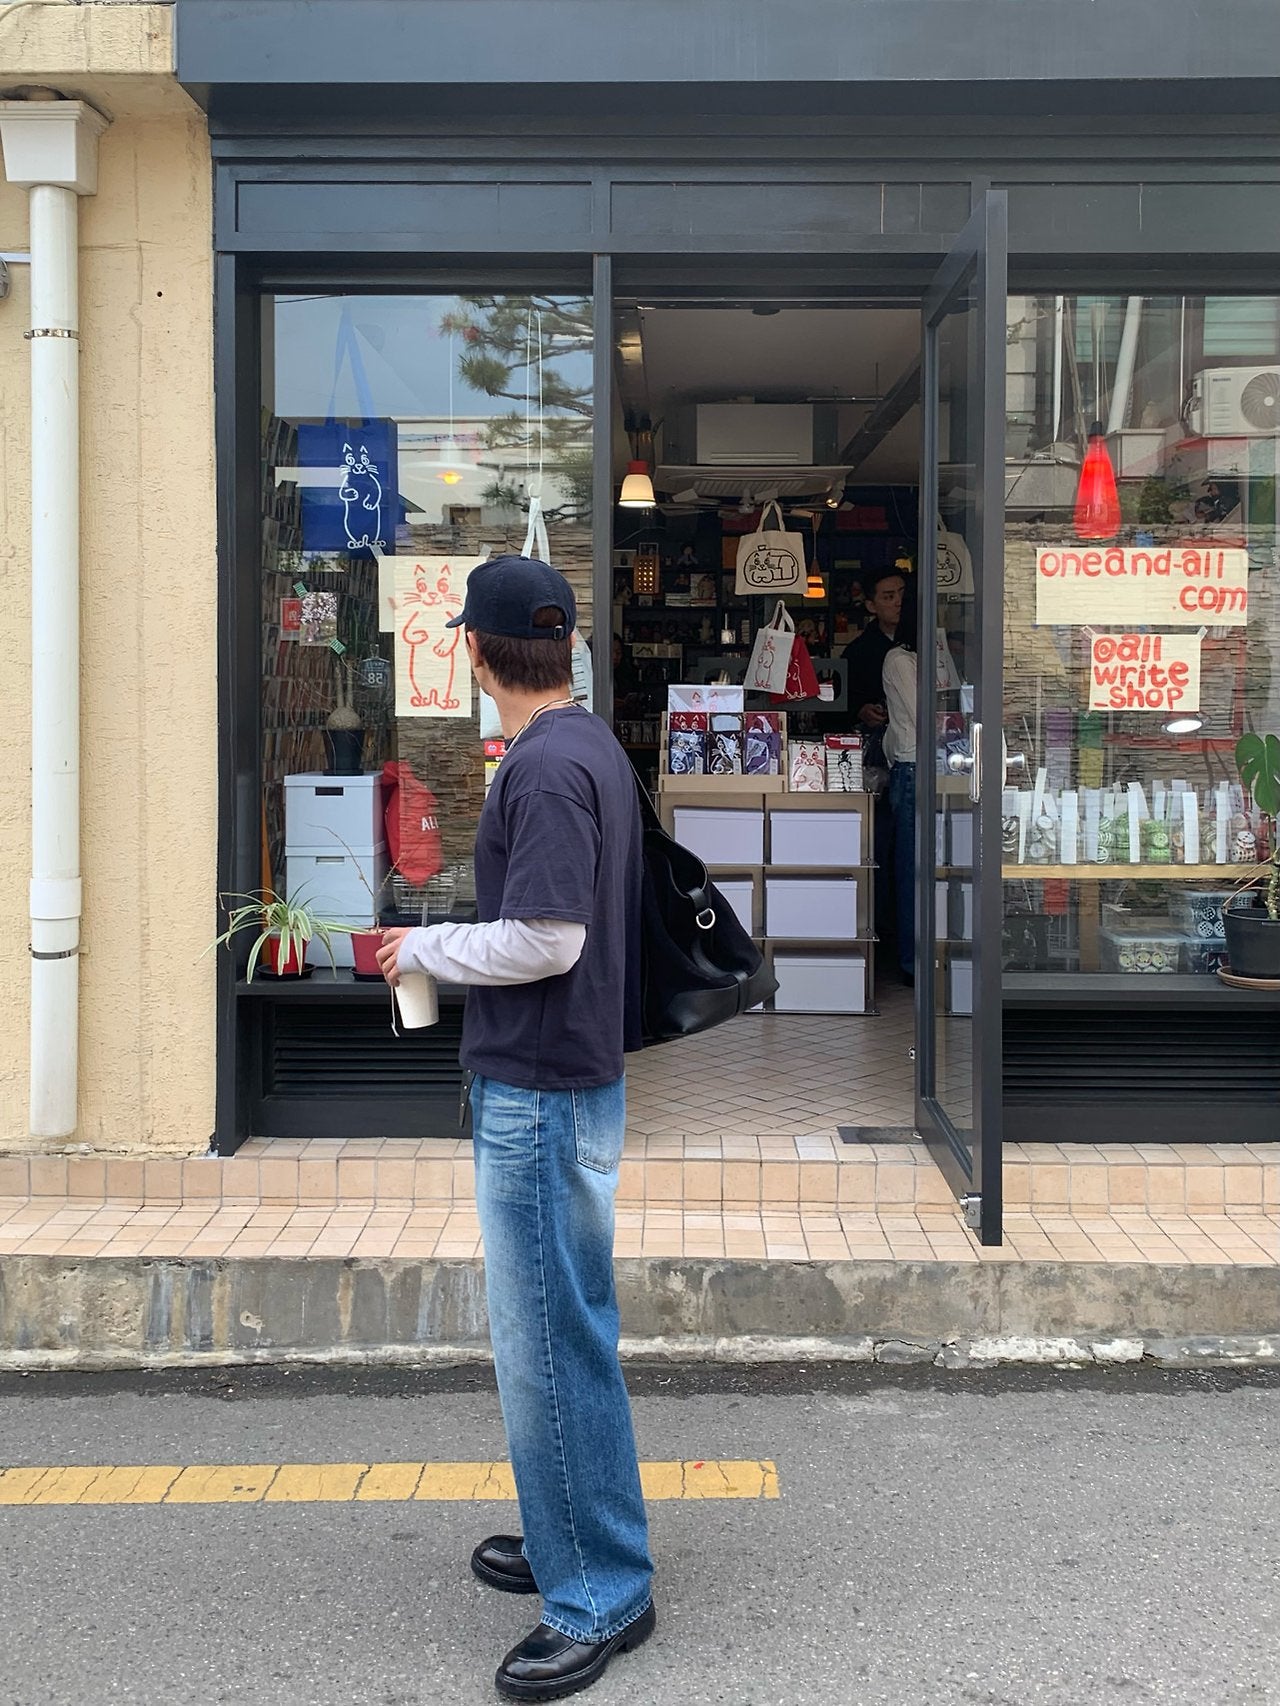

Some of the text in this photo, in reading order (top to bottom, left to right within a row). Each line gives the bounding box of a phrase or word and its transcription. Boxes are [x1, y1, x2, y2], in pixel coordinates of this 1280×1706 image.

[1039, 548, 1224, 579] oneand-all
[1093, 634, 1162, 663] @all
[1094, 661, 1189, 687] write
